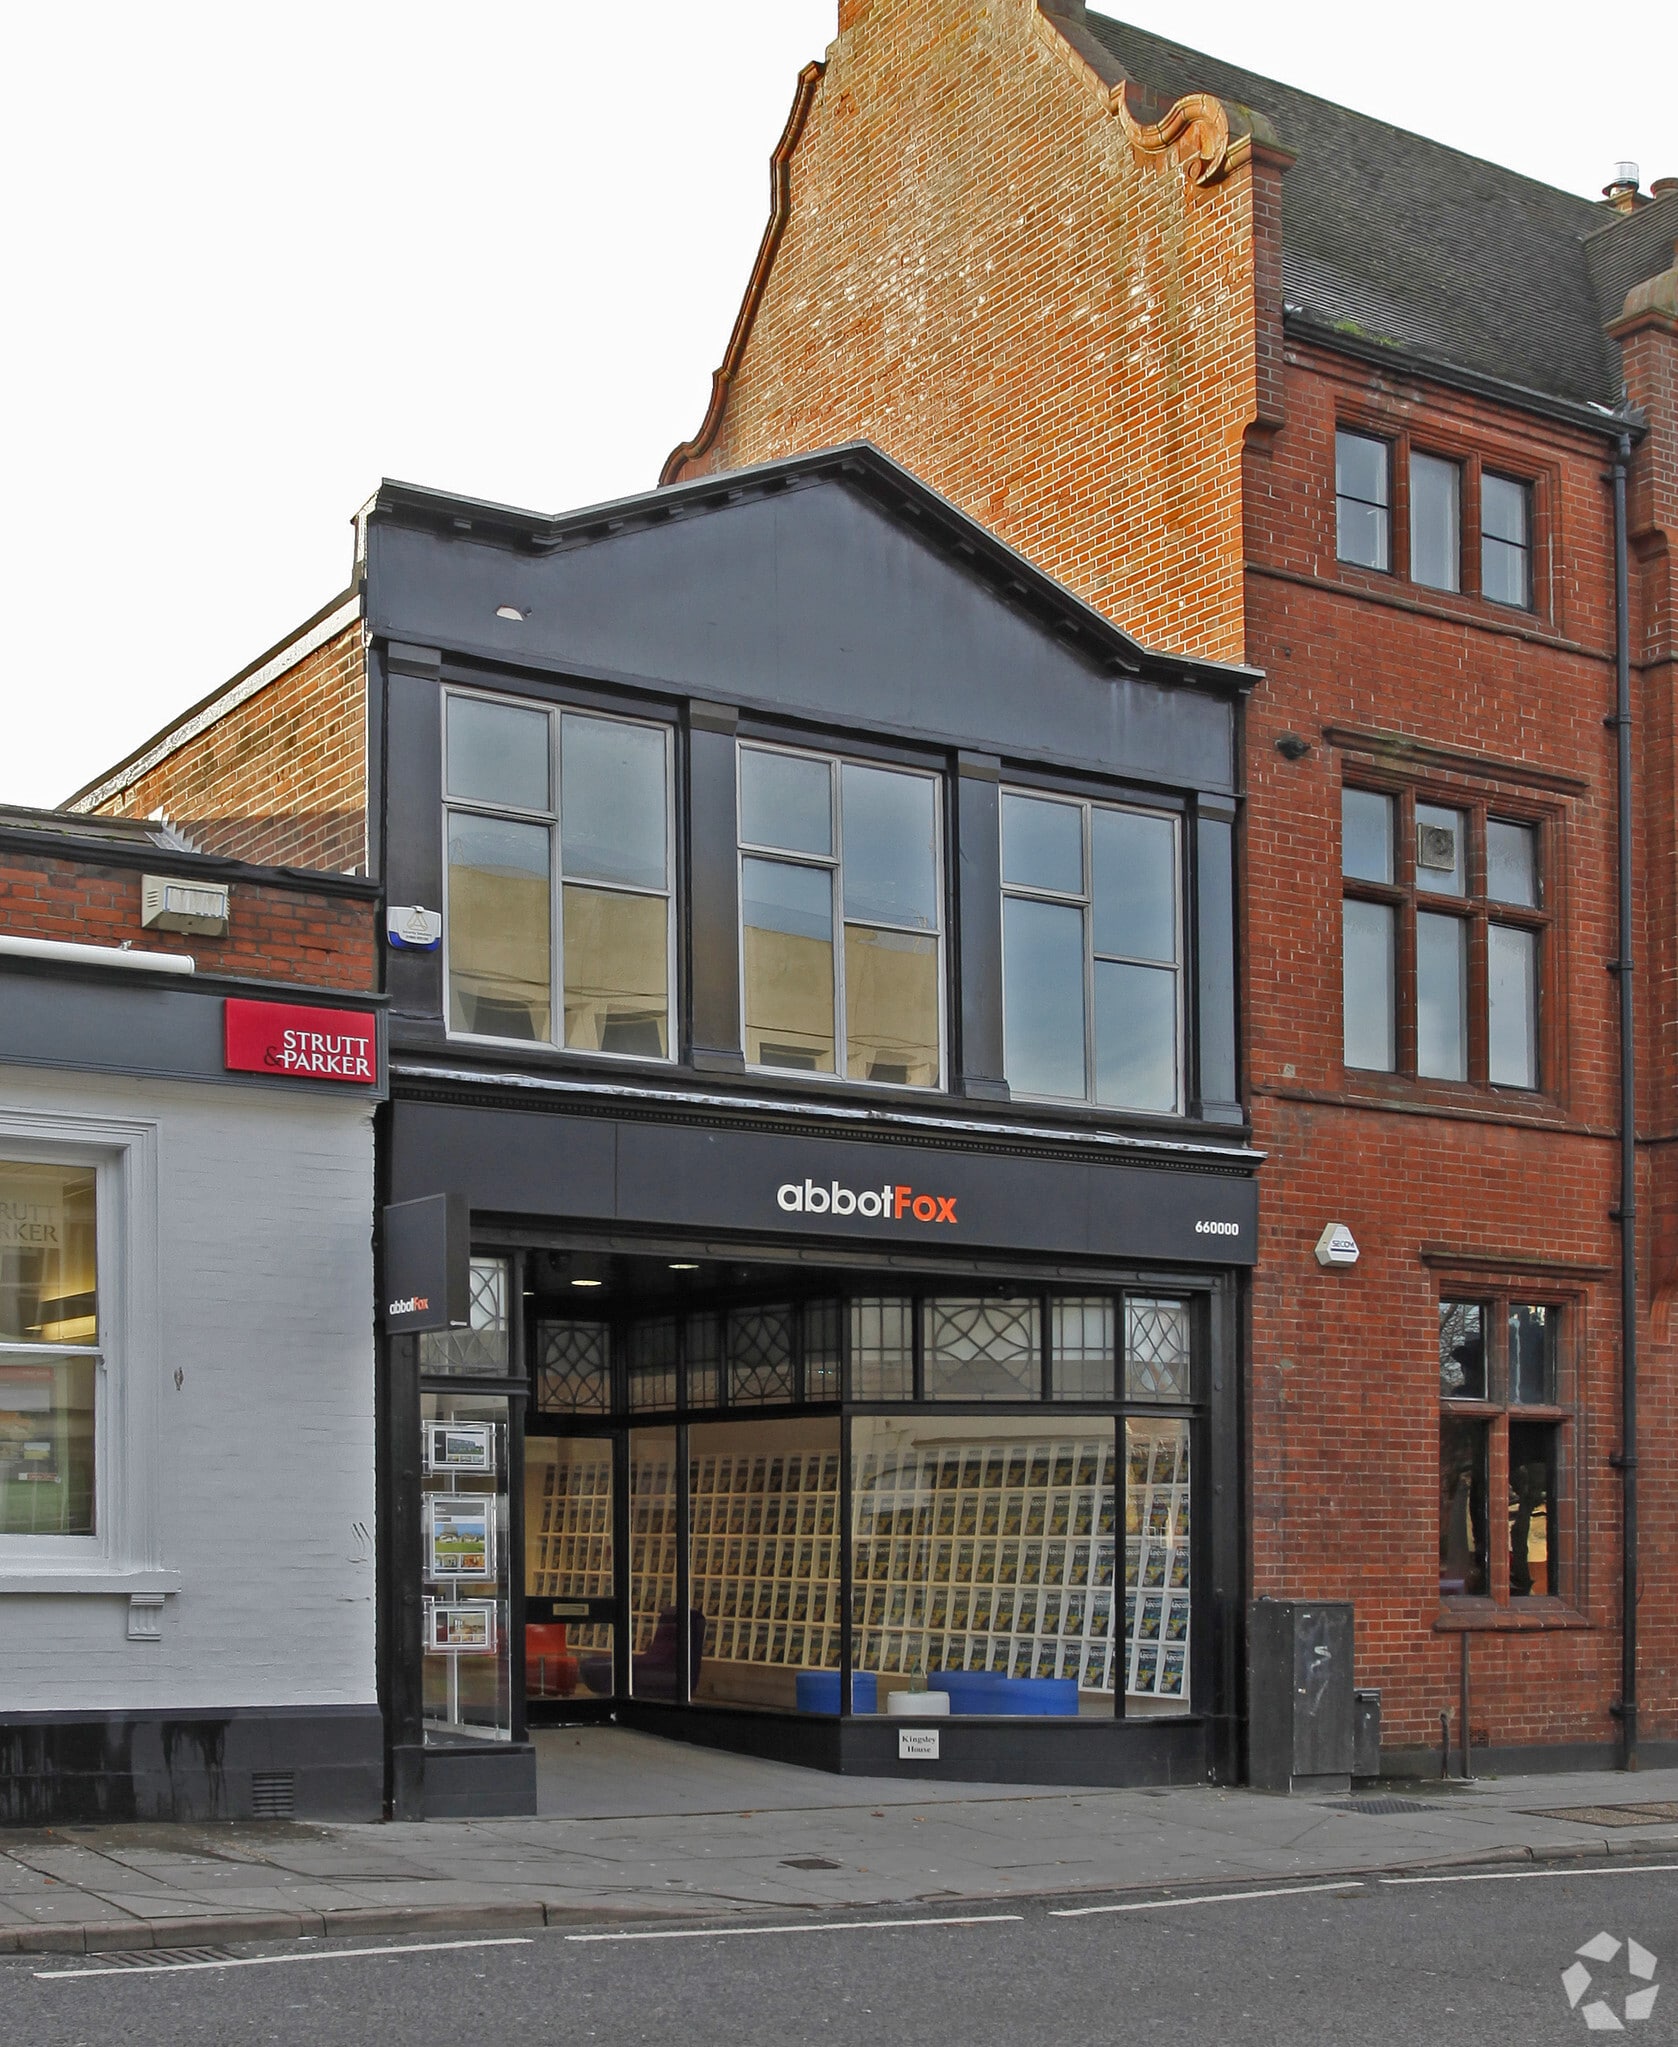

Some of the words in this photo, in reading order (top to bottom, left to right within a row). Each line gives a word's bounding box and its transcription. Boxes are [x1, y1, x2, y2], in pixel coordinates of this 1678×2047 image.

[283, 1030, 369, 1057] STRUTT
[276, 1050, 371, 1077] PARKER
[776, 1178, 958, 1224] abbotFox
[1195, 1220, 1239, 1236] 660000
[389, 1296, 429, 1315] abbotFox
[907, 1745, 931, 1753] House
